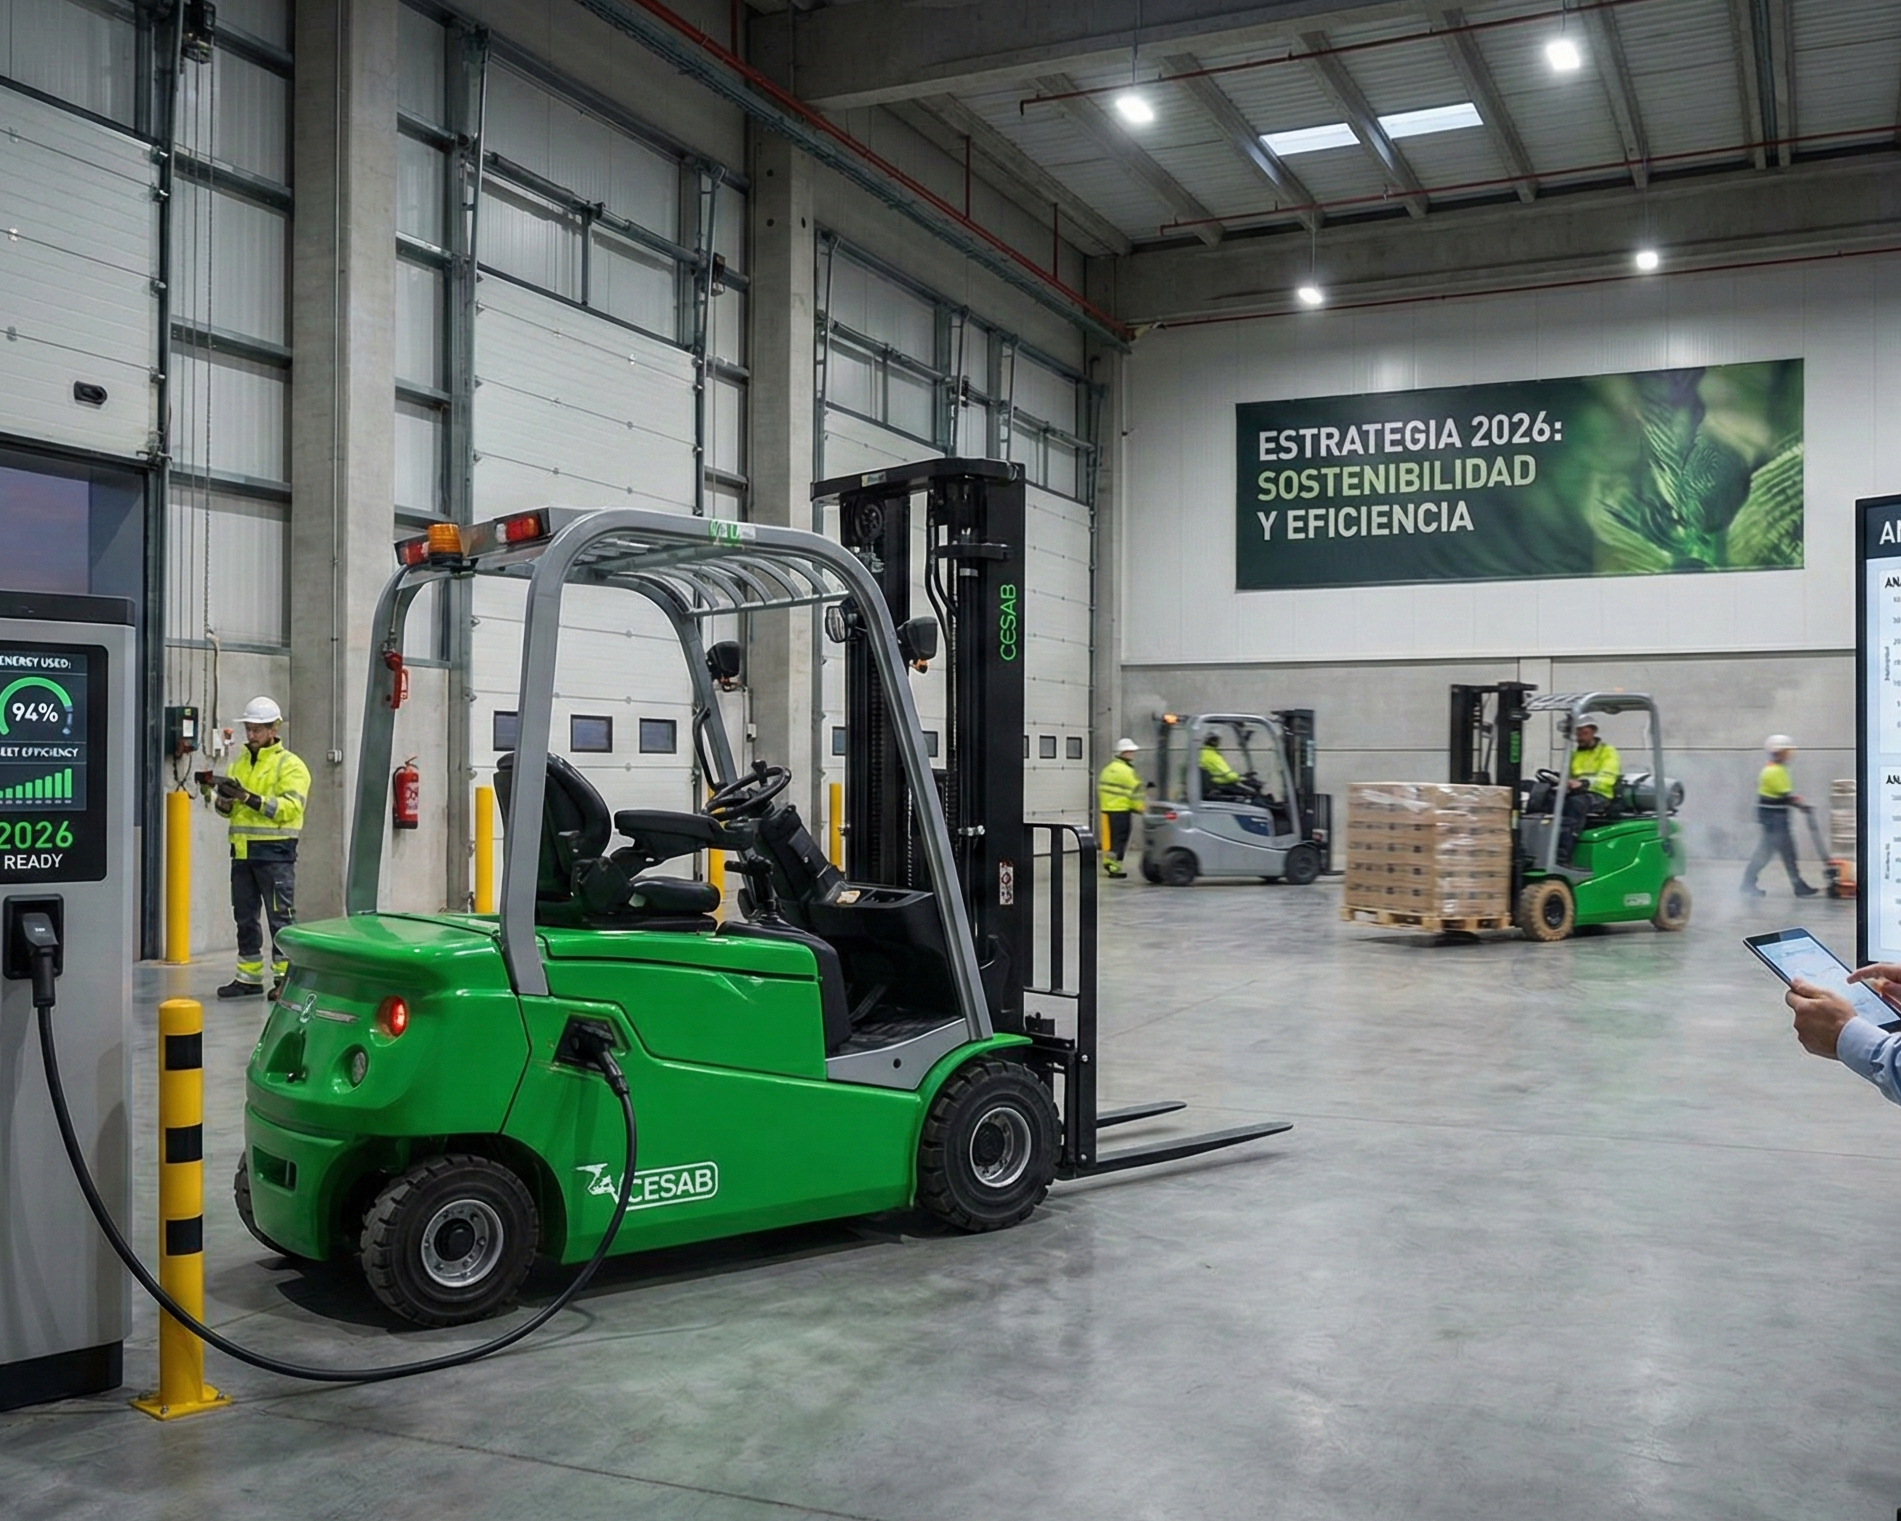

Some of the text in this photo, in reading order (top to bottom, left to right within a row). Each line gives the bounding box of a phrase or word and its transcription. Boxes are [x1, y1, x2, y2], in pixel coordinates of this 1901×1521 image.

[1258, 411, 1563, 461] ESTRATEGIA 2026:
[1257, 454, 1537, 501] SOSTENIBILIDAD
[1256, 500, 1475, 541] Y EFICIENCIA
[1000, 583, 1017, 662] CESAB
[12, 702, 59, 723] 94%
[0, 820, 74, 849] 2026
[4, 853, 63, 870] READY
[627, 1168, 713, 1204] CESAB
